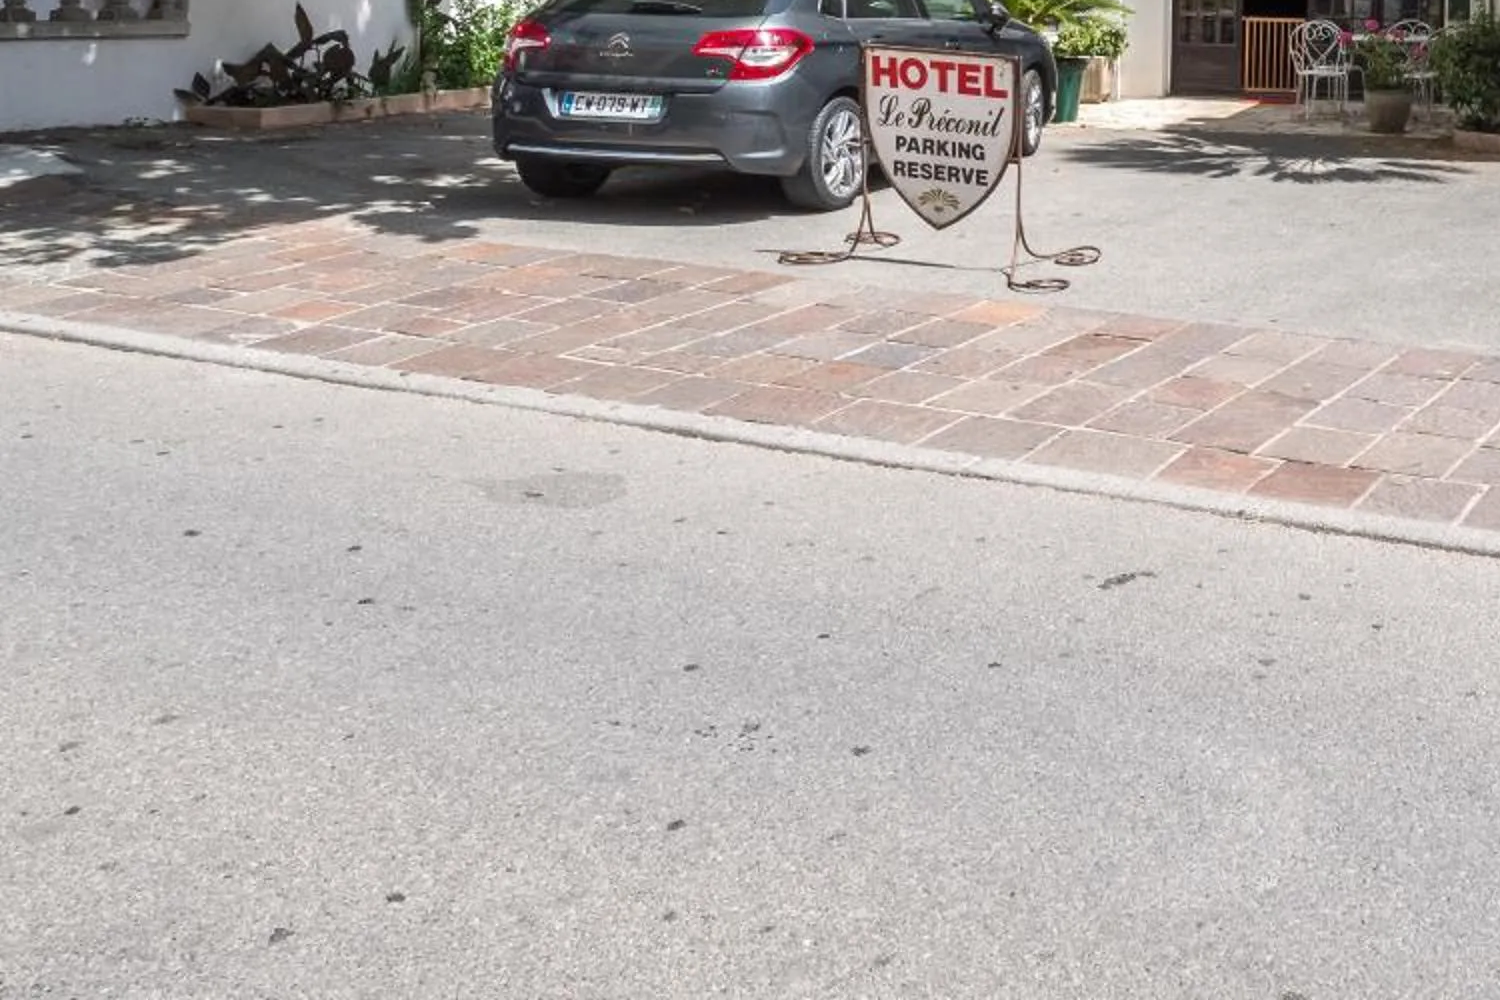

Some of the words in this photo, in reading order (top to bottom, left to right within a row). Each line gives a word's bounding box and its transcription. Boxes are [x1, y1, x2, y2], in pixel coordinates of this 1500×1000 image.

[871, 55, 1009, 99] HOTEL
[878, 94, 905, 127] Le
[907, 97, 1006, 138] Préconil
[895, 135, 986, 161] PARKING
[893, 160, 989, 187] RESERVE
